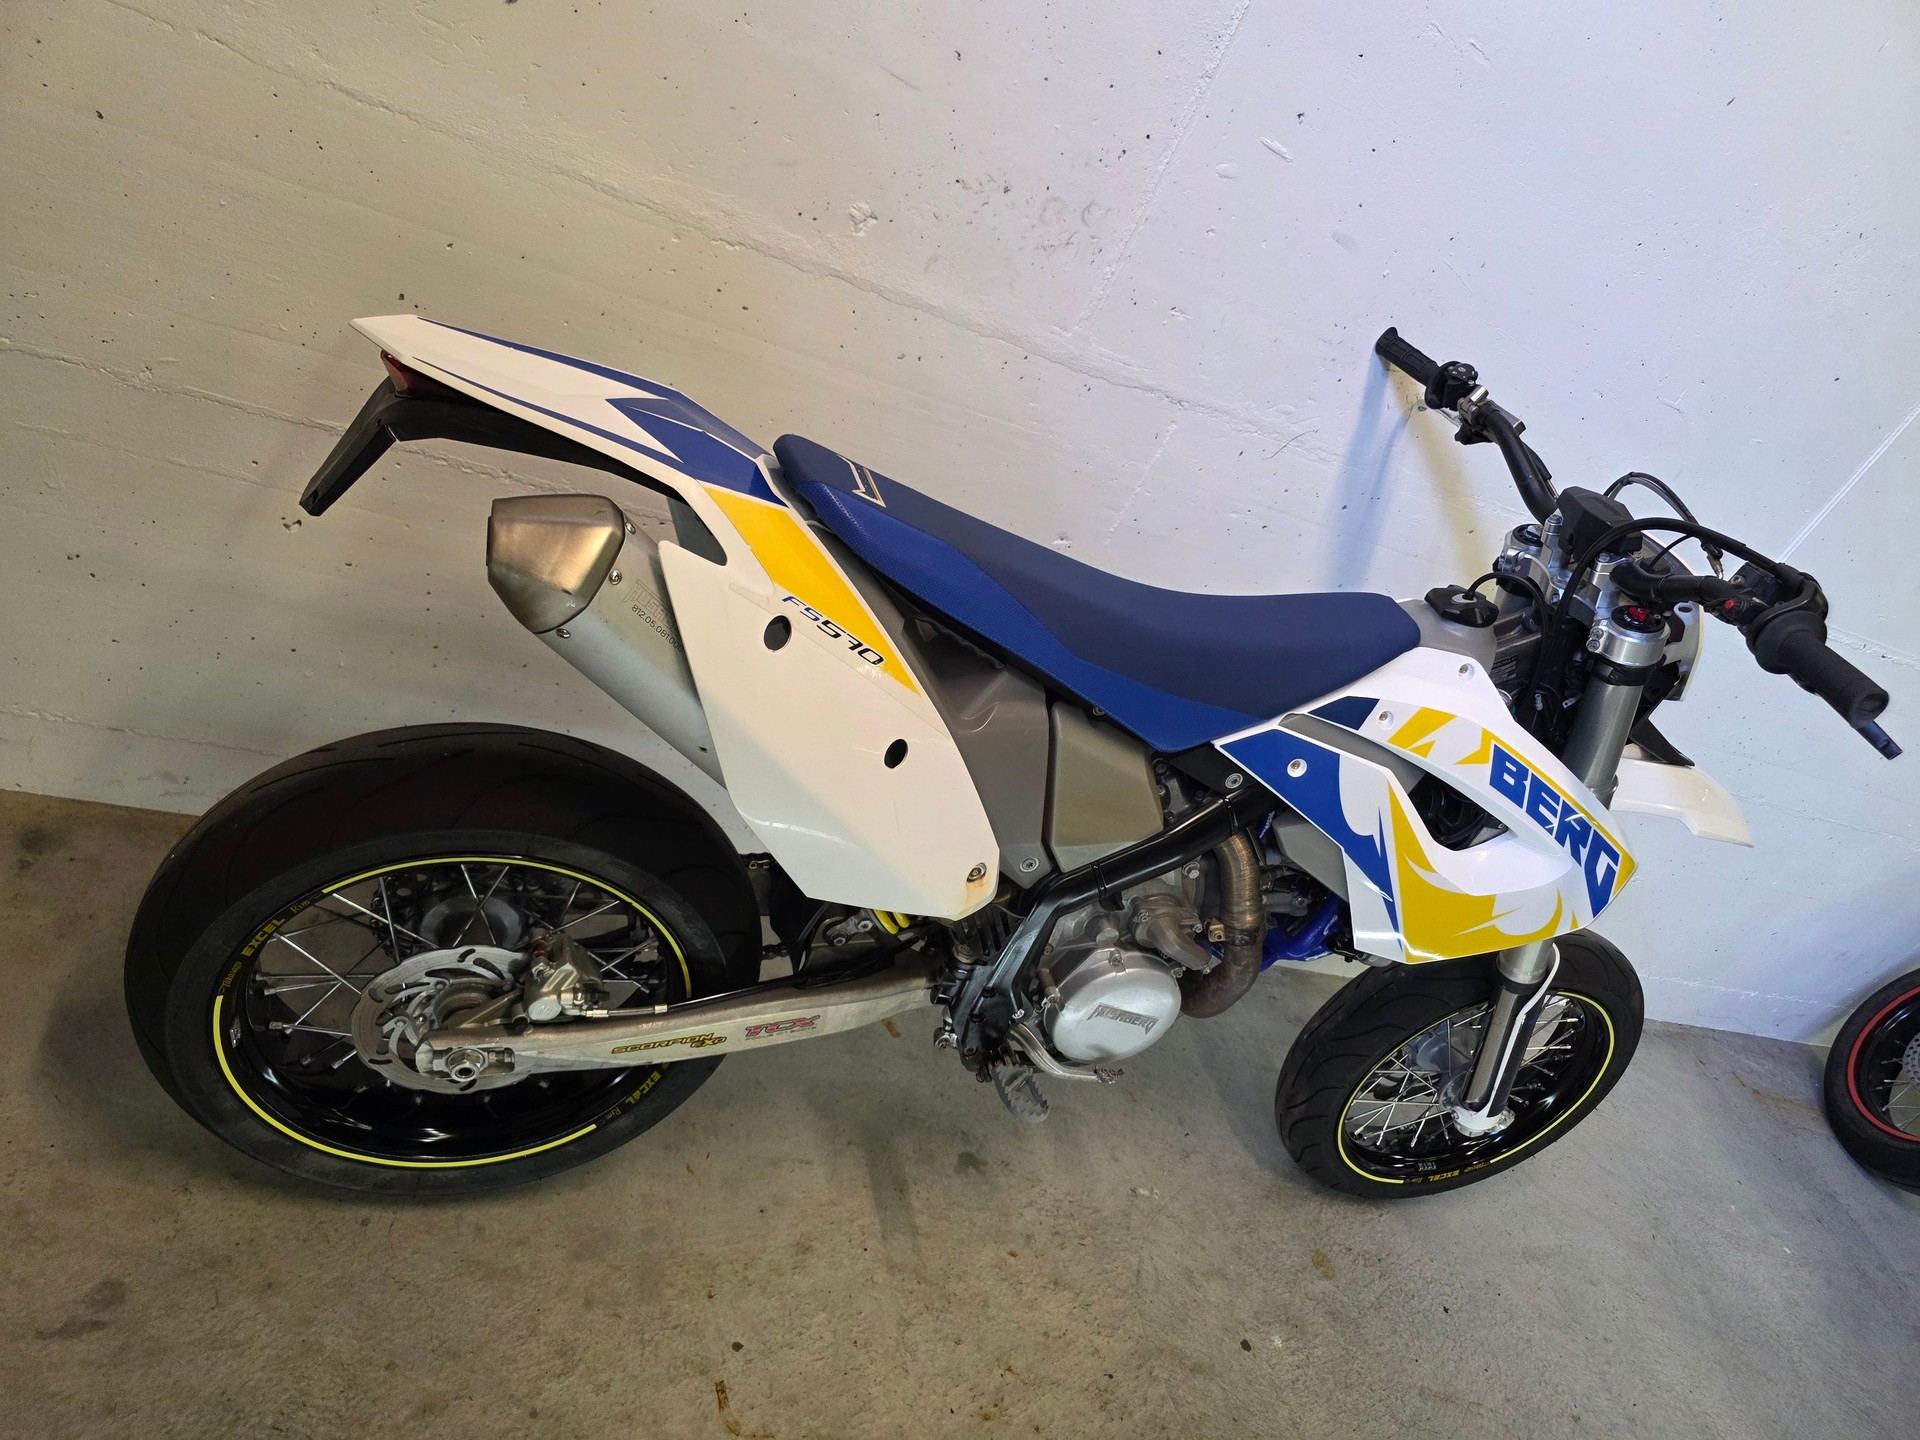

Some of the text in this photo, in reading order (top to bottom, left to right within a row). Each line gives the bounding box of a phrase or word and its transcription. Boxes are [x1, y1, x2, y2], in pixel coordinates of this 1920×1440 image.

[782, 596, 884, 665] FS570
[1489, 743, 1620, 919] BERG
[240, 918, 285, 957] EXCEL
[611, 1033, 714, 1054] SCORPION
[745, 1015, 821, 1037] TCX
[625, 1070, 662, 1105] EXCEL
[1427, 1169, 1460, 1182] EXCEL
